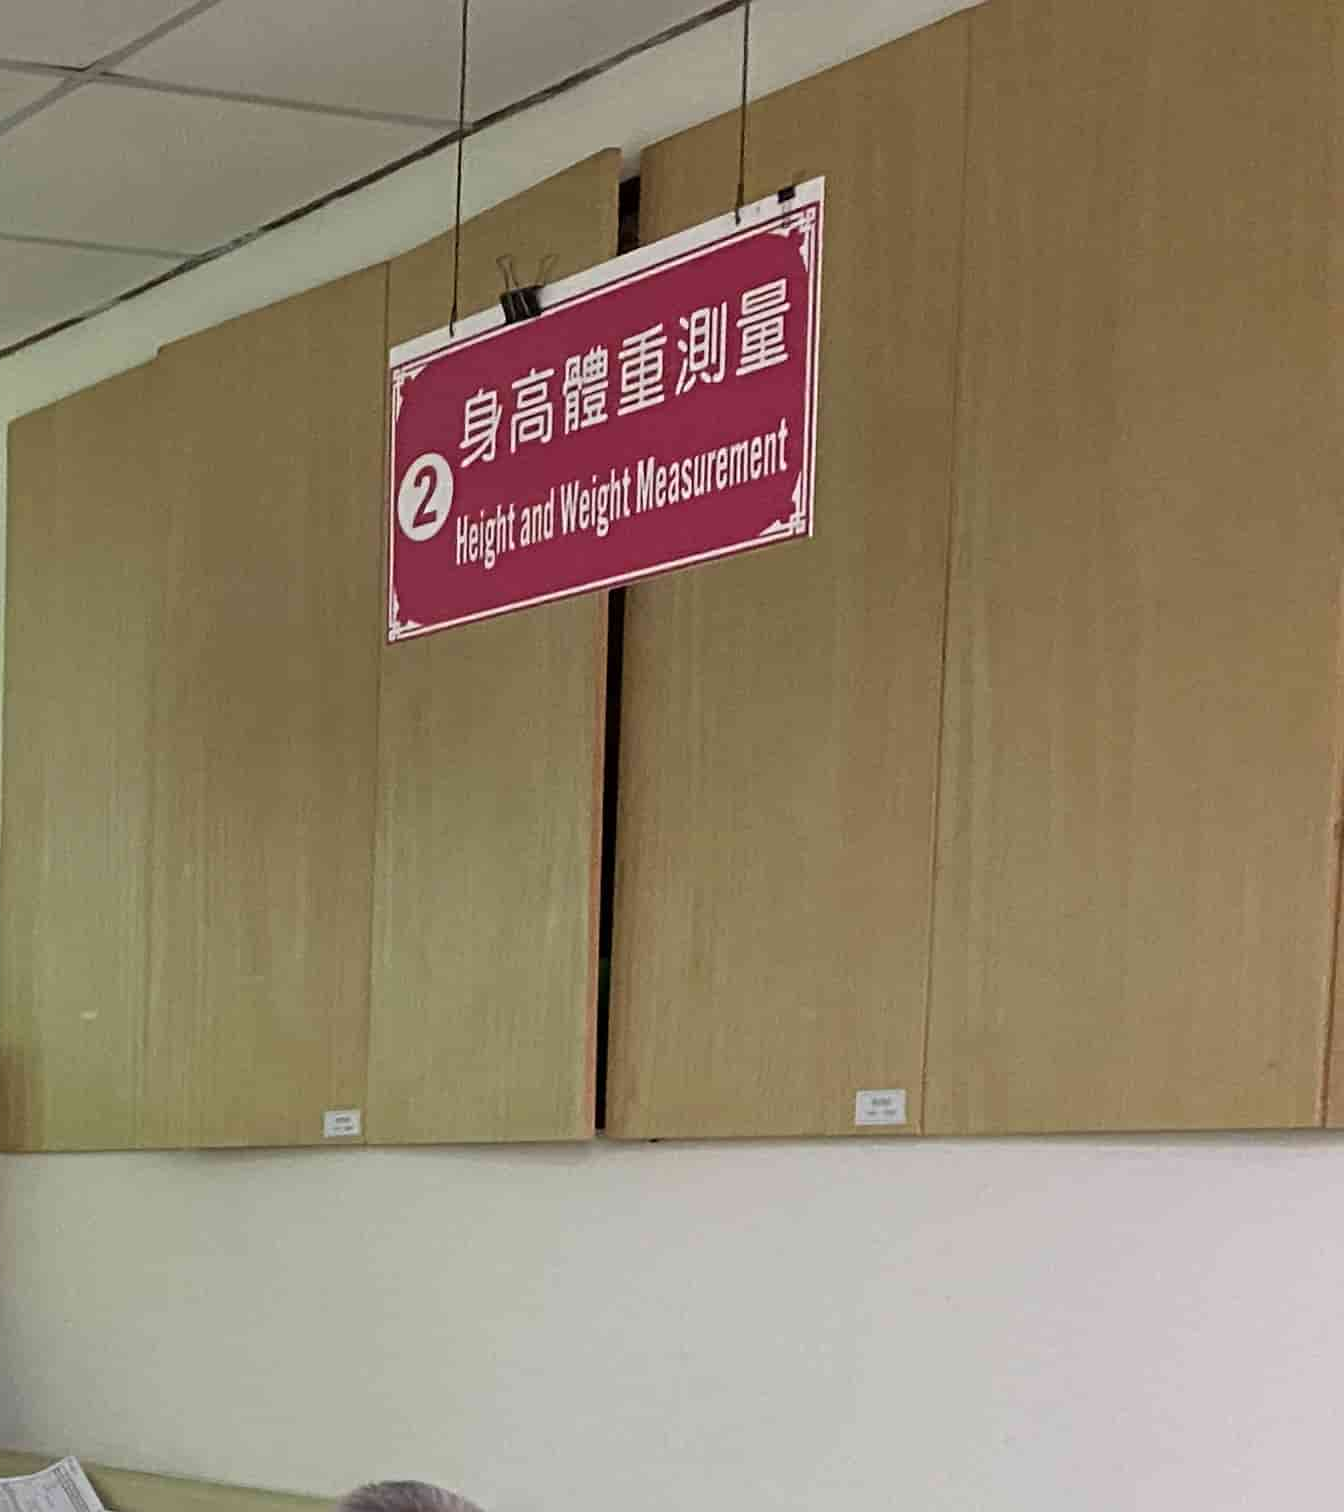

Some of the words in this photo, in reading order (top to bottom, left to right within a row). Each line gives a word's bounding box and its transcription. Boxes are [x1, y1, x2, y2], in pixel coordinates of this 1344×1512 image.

[459, 278, 791, 468] 身高體重測量
[456, 510, 516, 569] Height
[520, 490, 554, 549] and
[560, 468, 631, 537] Weight
[636, 417, 789, 514] Measurement
